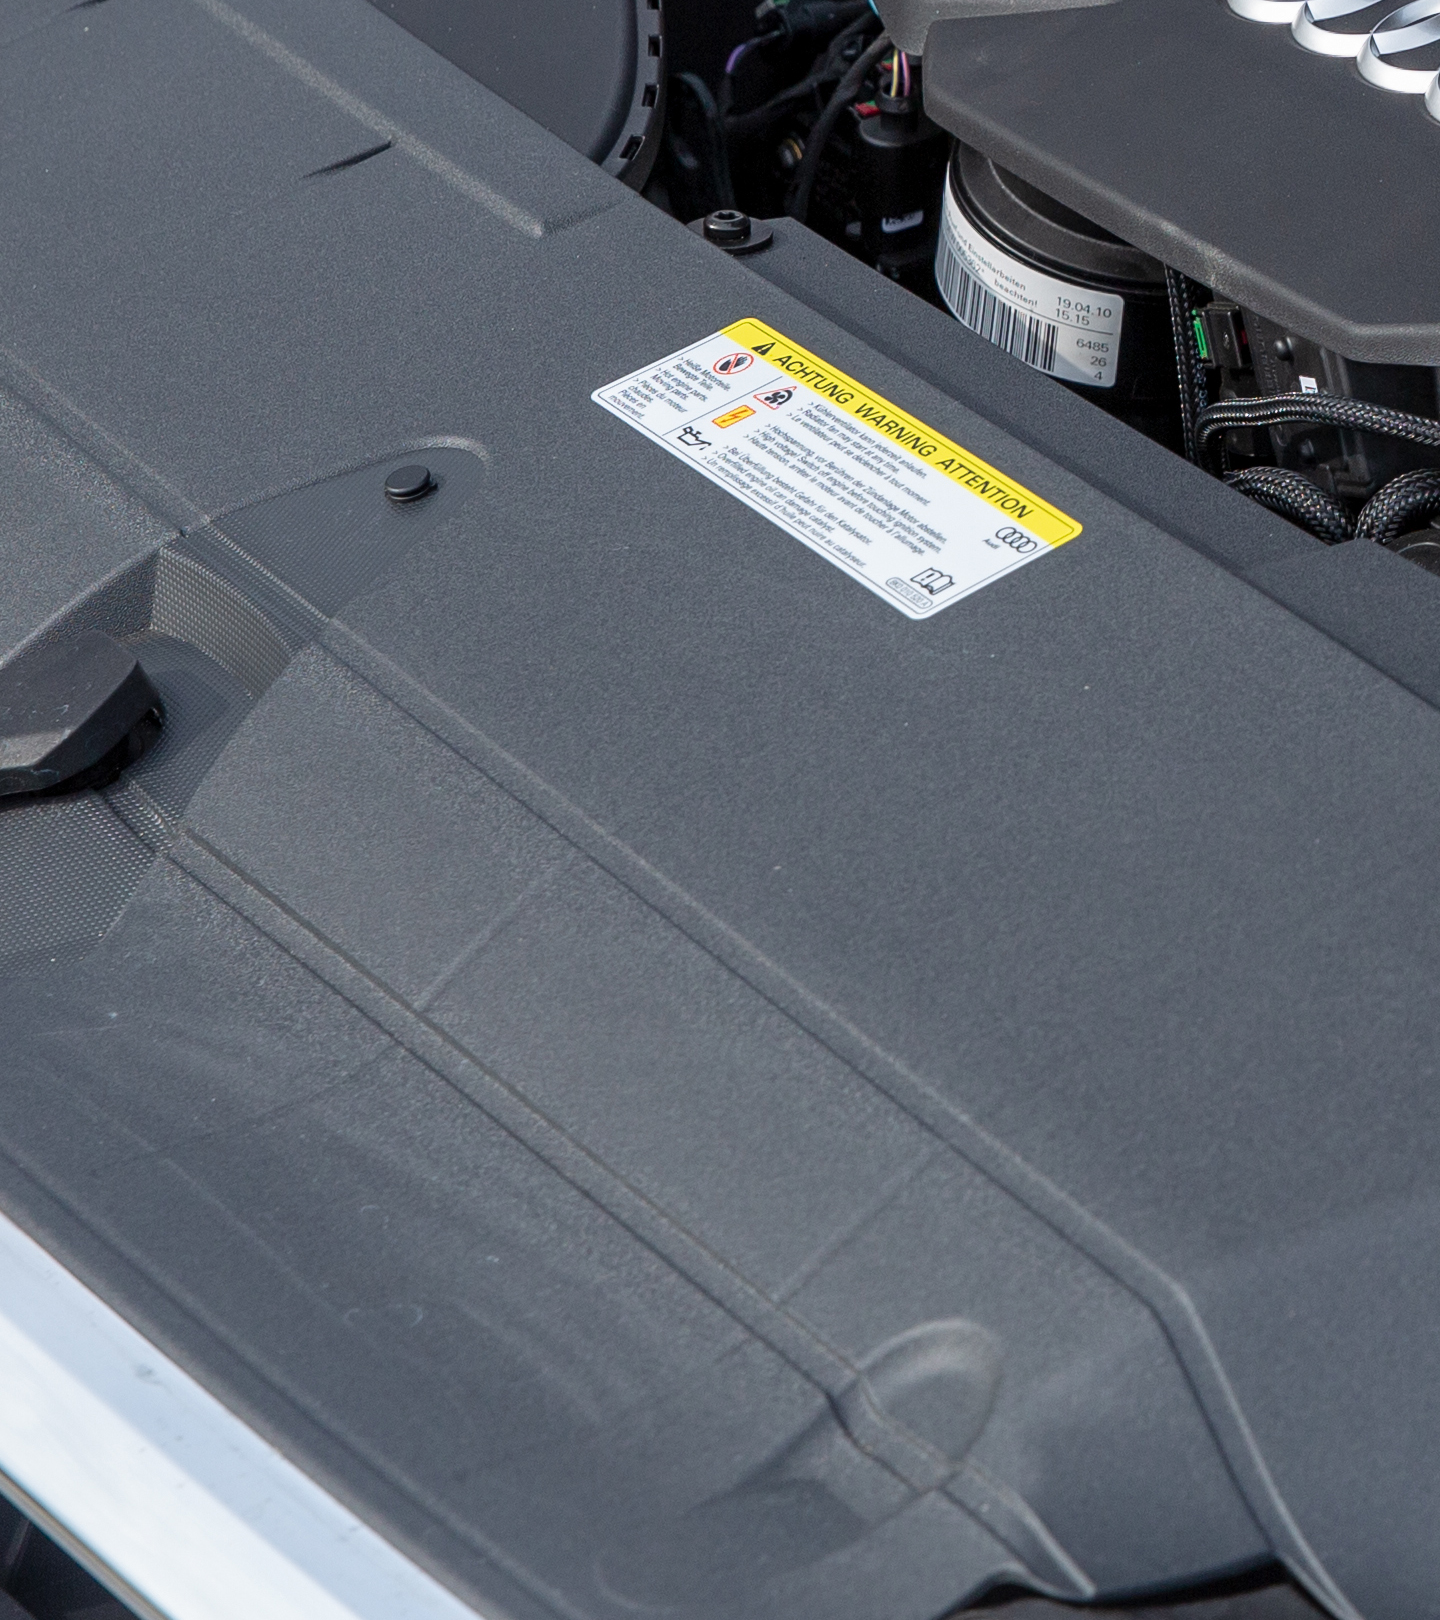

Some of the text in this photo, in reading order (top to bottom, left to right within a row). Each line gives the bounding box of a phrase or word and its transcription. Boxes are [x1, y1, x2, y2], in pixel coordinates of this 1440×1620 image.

[994, 279, 1038, 307] beachten!
[1057, 296, 1112, 319] 19.04.10
[1055, 308, 1090, 326] 15.15
[1076, 338, 1109, 354] 6485
[1090, 356, 1107, 368] 26
[649, 373, 689, 400] Moving parts.
[659, 368, 708, 402] Hot engine parts.
[671, 362, 713, 391] Bewegte Teile.
[682, 358, 731, 391] Heiße Motorteile.
[1094, 370, 1103, 381] 4
[608, 394, 645, 419] mouvement.
[617, 388, 647, 409] Pièces en
[627, 384, 654, 403] chaudes.
[637, 379, 688, 413] Pièces du moteur
[772, 354, 1032, 518] ACHTUNG WARNING ATTENTION
[801, 408, 900, 474] Radiator fan may start at any time.
[812, 403, 927, 479] Kühlerventilator kann jederzeit anlaufen.
[790, 413, 802, 423] Le
[799, 420, 833, 442] ventilateur
[827, 439, 848, 452] peut
[842, 448, 854, 456] se
[851, 454, 886, 476] déclencher
[887, 477, 905, 489] tout
[901, 486, 931, 506] moment.
[716, 452, 835, 533] Overfilled engine oil can damage catalyst.
[726, 446, 872, 544] Bei Überfüllung besteht Gefahr für den Katalysator.
[747, 435, 768, 450] Haute
[764, 447, 790, 466] tension,
[787, 463, 812, 478] arrêter
[808, 475, 818, 483] le
[815, 480, 840, 497] moteur
[836, 495, 858, 509] avant
[853, 506, 865, 515] de
[862, 511, 889, 530] toucher
[758, 430, 941, 553] High voltage! Switch off engine before touching ignition system.
[769, 425, 947, 544] Hochspannung, vor Berühren der Zündanlage Motor abstellen.
[705, 457, 718, 467] Un
[716, 464, 753, 490] remplissage
[749, 488, 779, 506] excessif
[792, 517, 812, 530] peut
[807, 527, 827, 541] nuire
[823, 538, 835, 547] au
[832, 544, 866, 567] catalyseur.
[982, 537, 1000, 550] Audi
